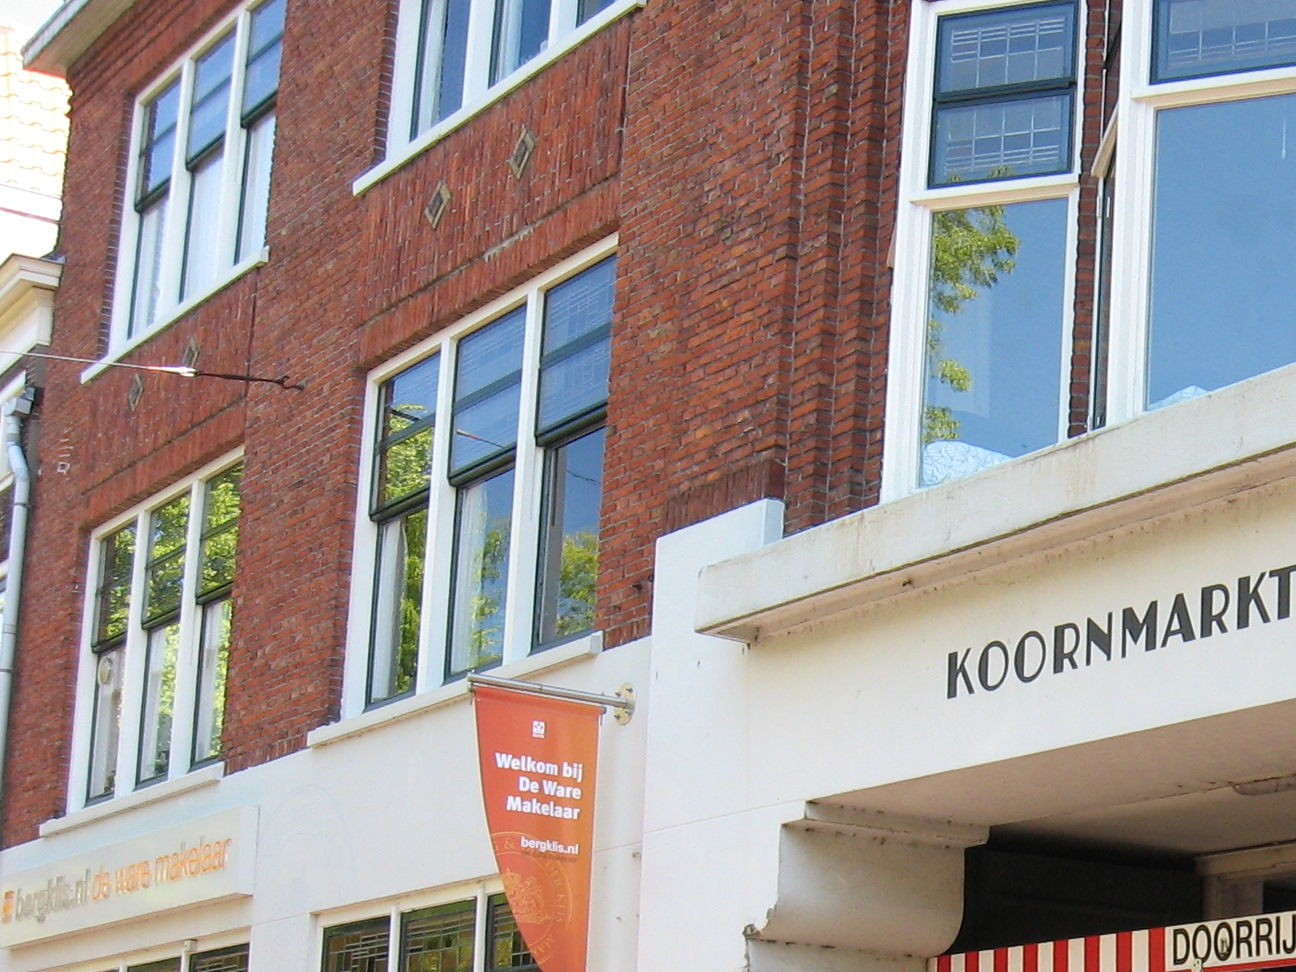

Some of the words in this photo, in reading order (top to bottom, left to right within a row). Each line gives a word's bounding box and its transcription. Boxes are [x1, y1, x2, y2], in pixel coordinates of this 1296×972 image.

[495, 752, 559, 776] Welkom
[562, 761, 583, 783] bij
[519, 776, 540, 793] De
[543, 779, 582, 800] Ware
[506, 796, 581, 820] Makelaar
[520, 836, 579, 855] bergklis.nl
[115, 860, 151, 894] ware
[155, 836, 232, 887] makelaar
